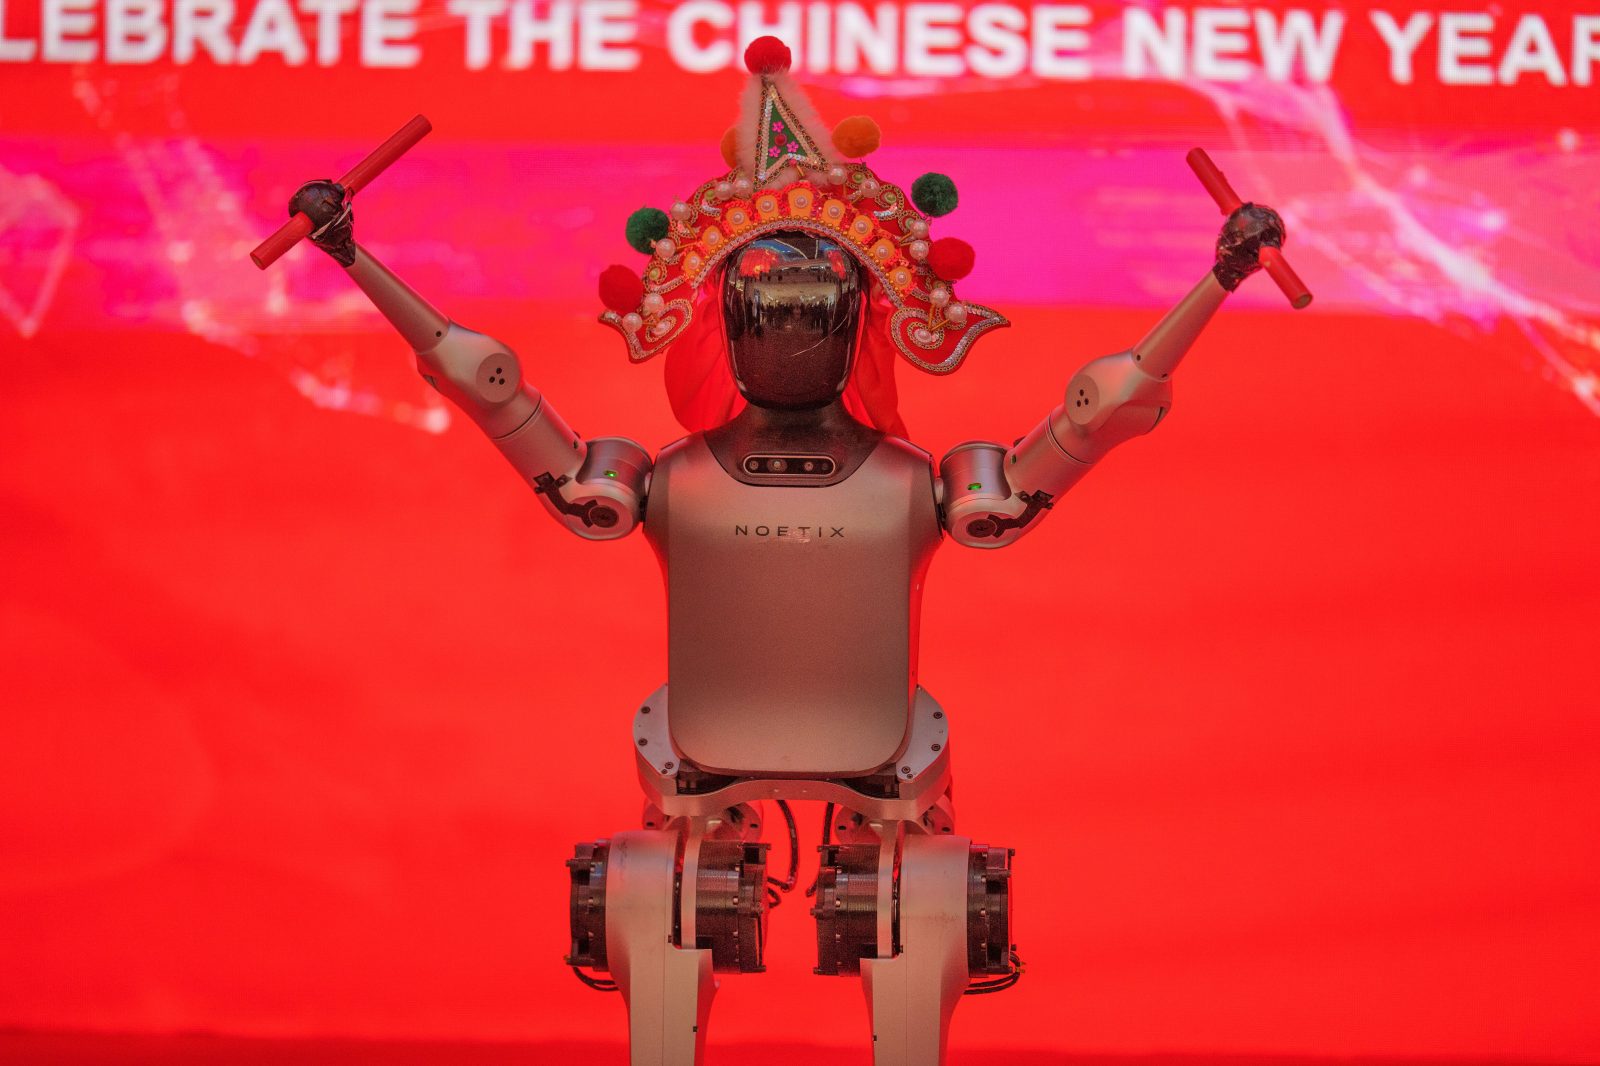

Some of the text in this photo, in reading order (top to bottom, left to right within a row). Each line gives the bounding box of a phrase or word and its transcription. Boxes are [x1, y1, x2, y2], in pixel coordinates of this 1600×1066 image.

[446, 0, 641, 71] THE
[667, 0, 1091, 77] CHINESE
[1122, 6, 1344, 82] NEW
[735, 524, 844, 538] NOETIX
